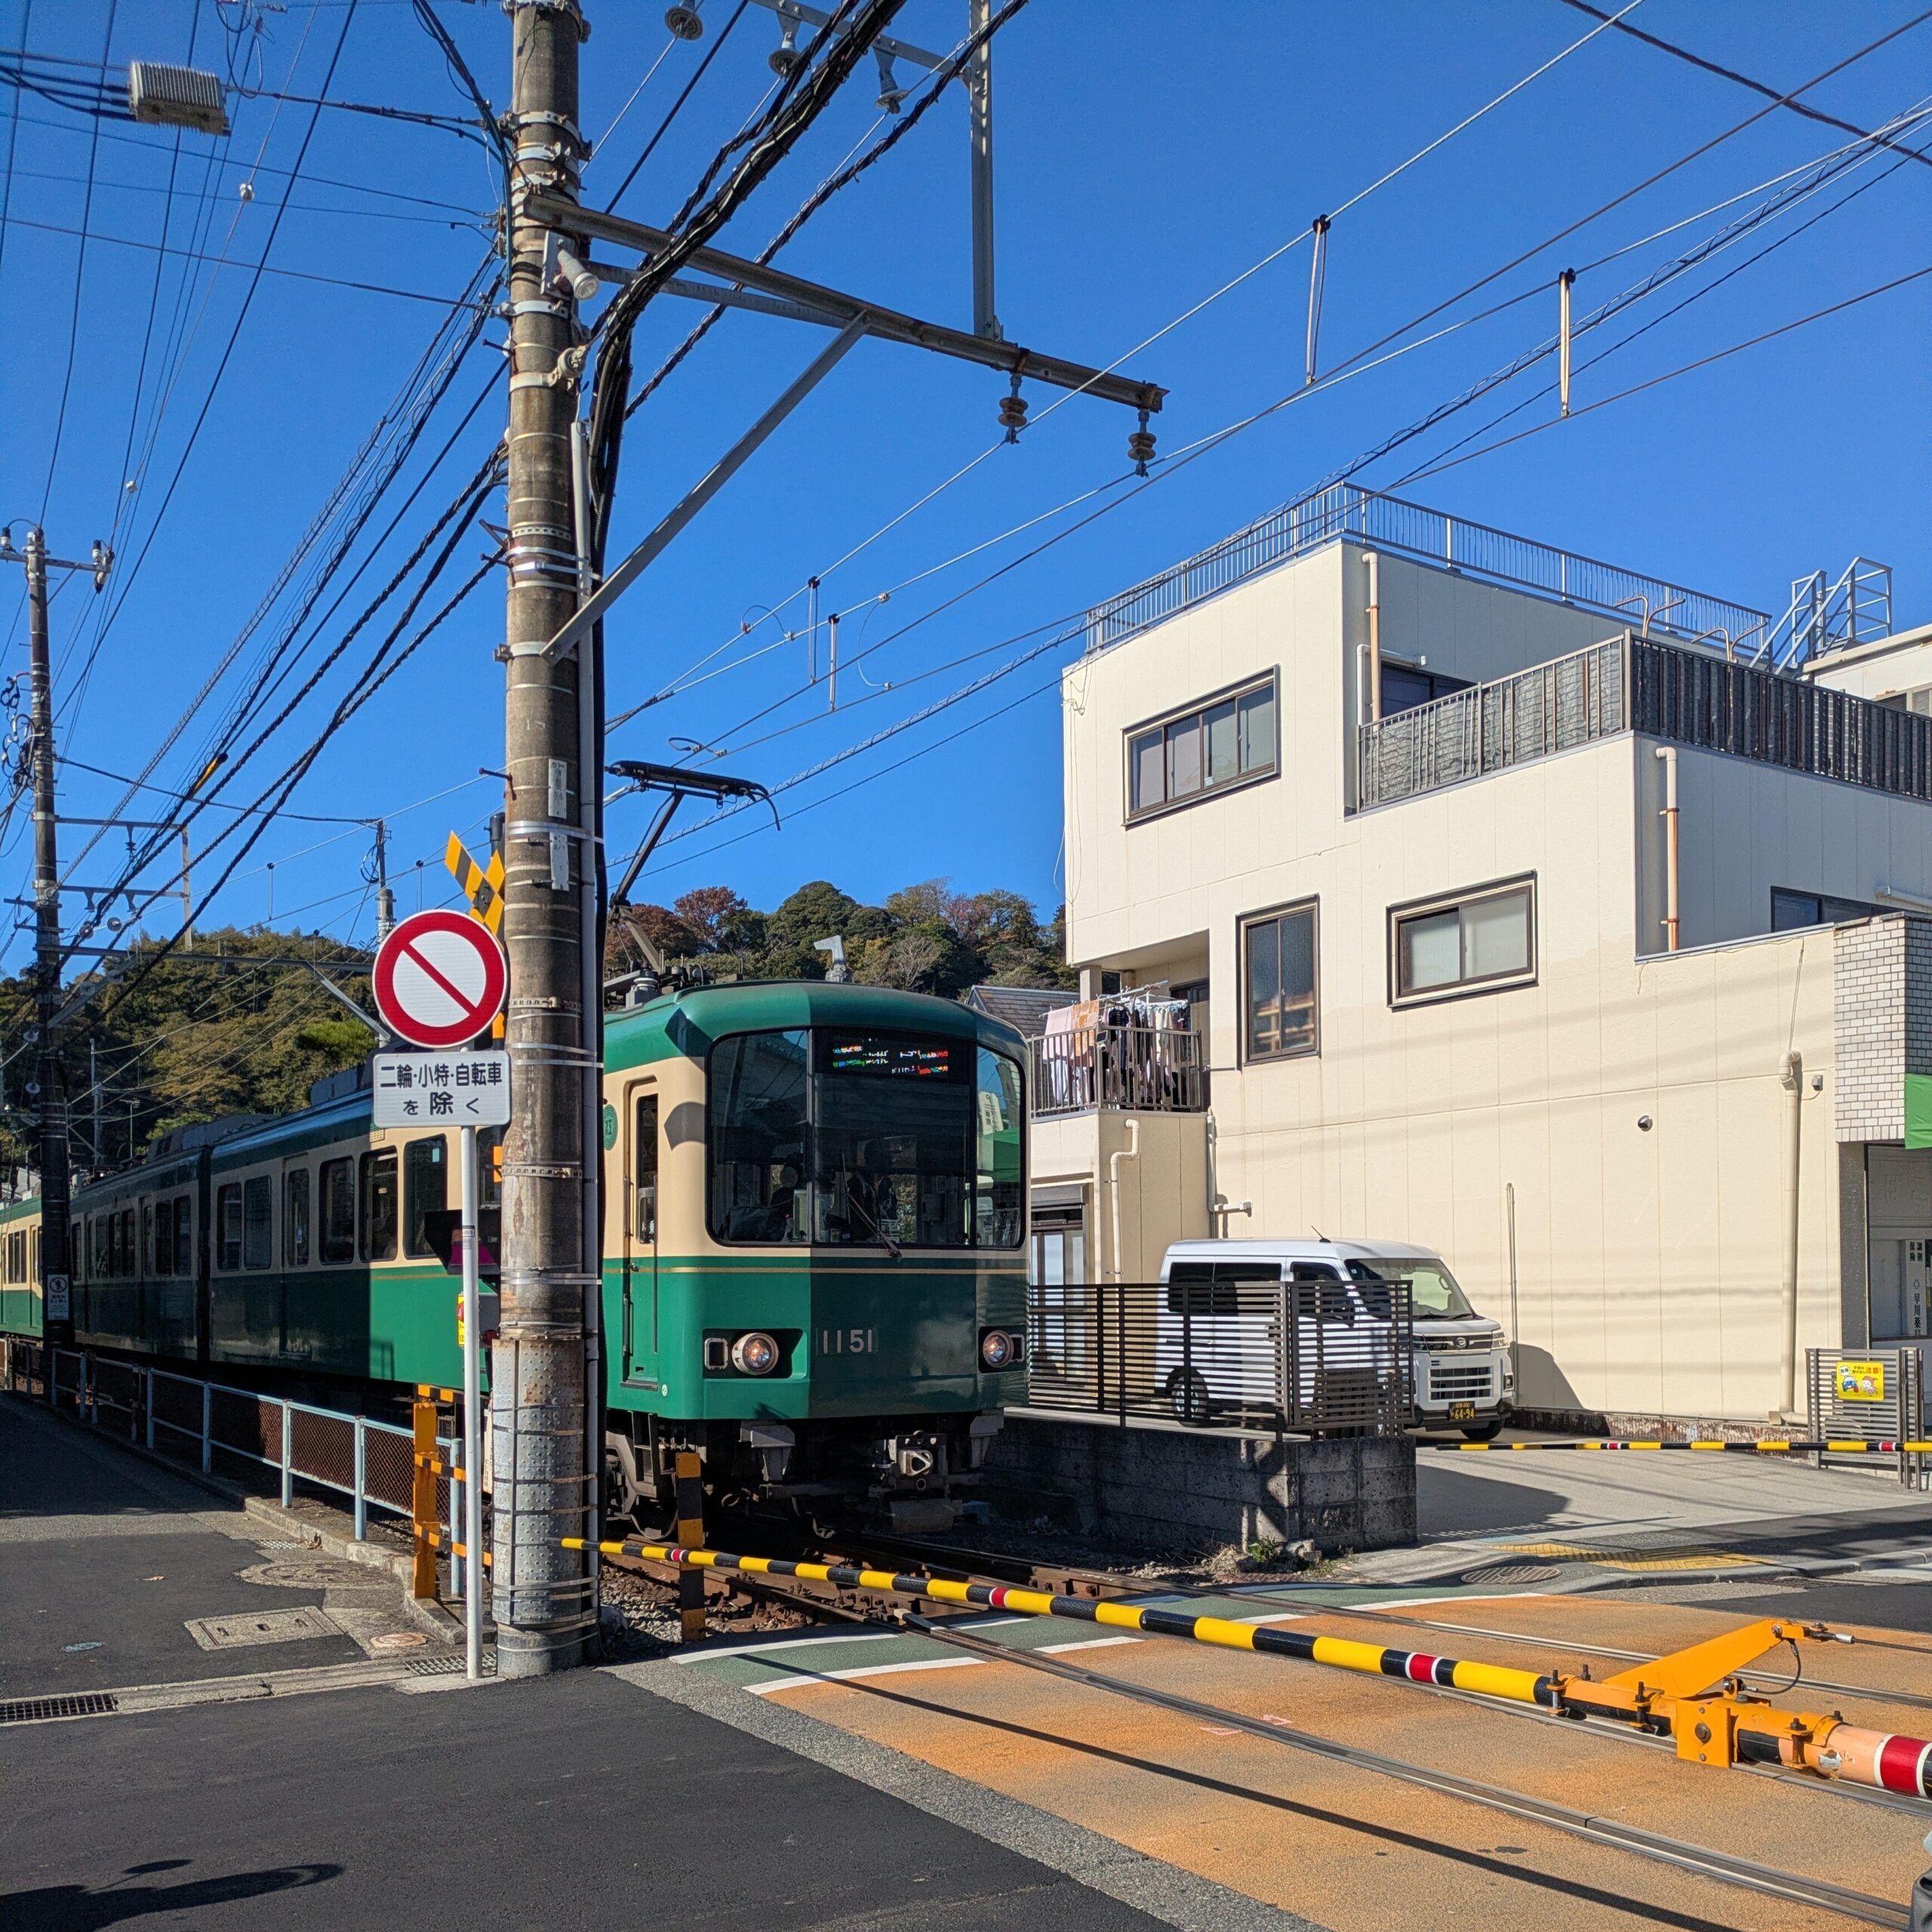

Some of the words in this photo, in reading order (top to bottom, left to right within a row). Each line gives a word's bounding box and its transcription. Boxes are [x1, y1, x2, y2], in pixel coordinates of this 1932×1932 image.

[380, 1061, 503, 1089] 二輪・小特・自転車
[403, 1091, 480, 1115] を除く
[823, 1329, 872, 1354] 1151
[1454, 1407, 1475, 1420] 64-94
